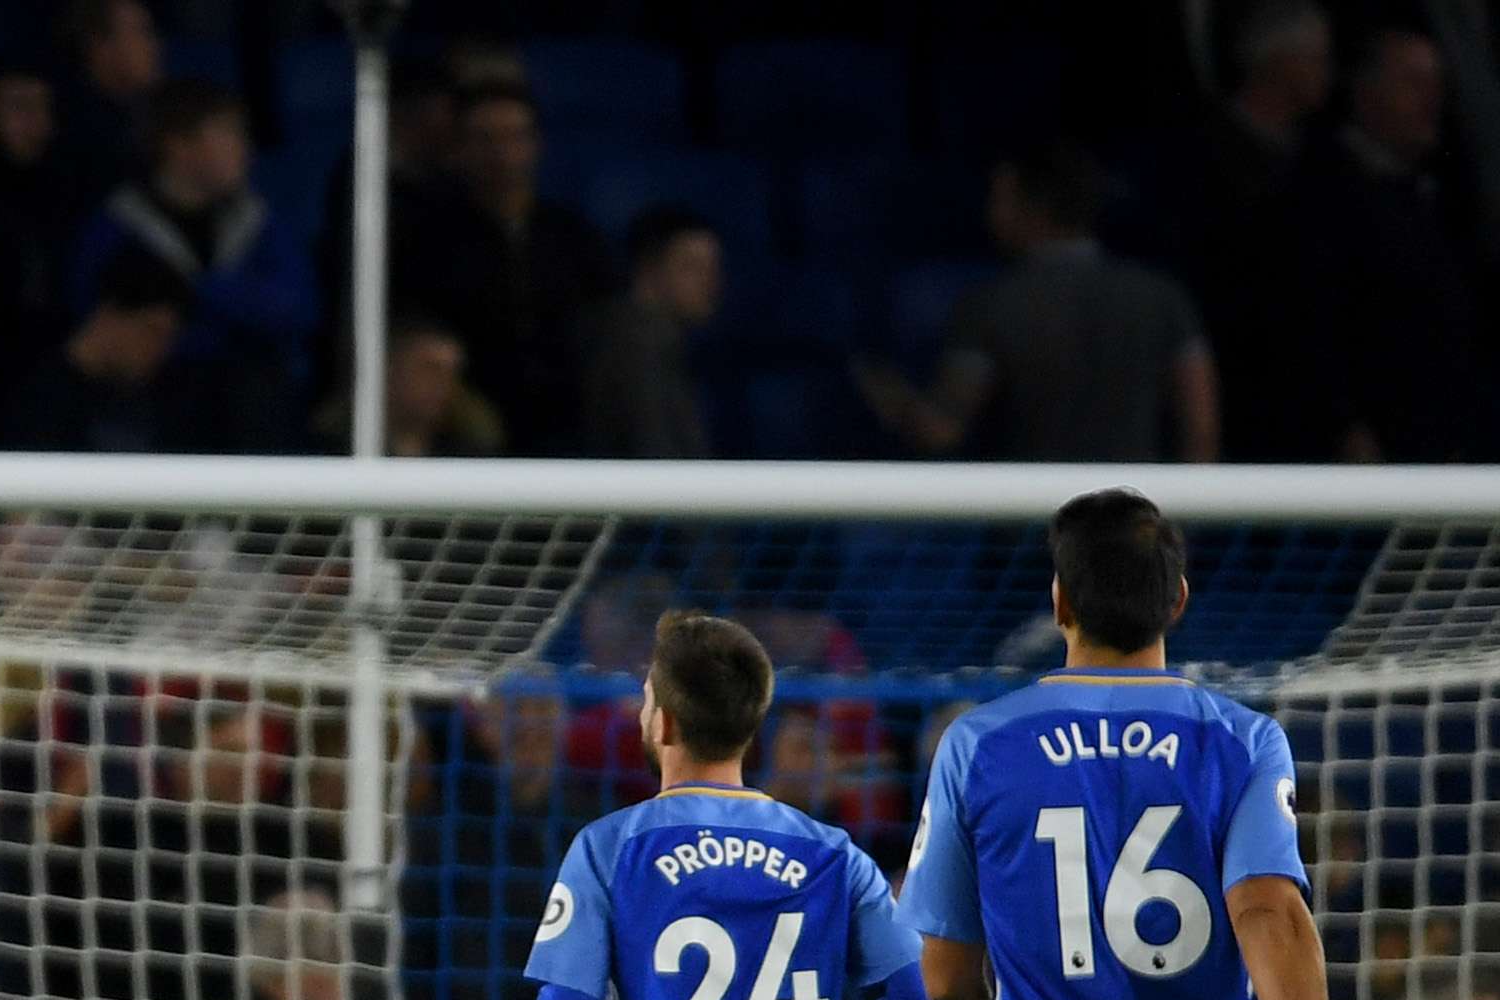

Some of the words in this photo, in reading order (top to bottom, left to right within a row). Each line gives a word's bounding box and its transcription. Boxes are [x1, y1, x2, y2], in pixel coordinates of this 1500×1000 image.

[1038, 718, 1180, 770] ULLOA
[654, 829, 808, 889] PRÖPPER
[1035, 804, 1212, 981] 16
